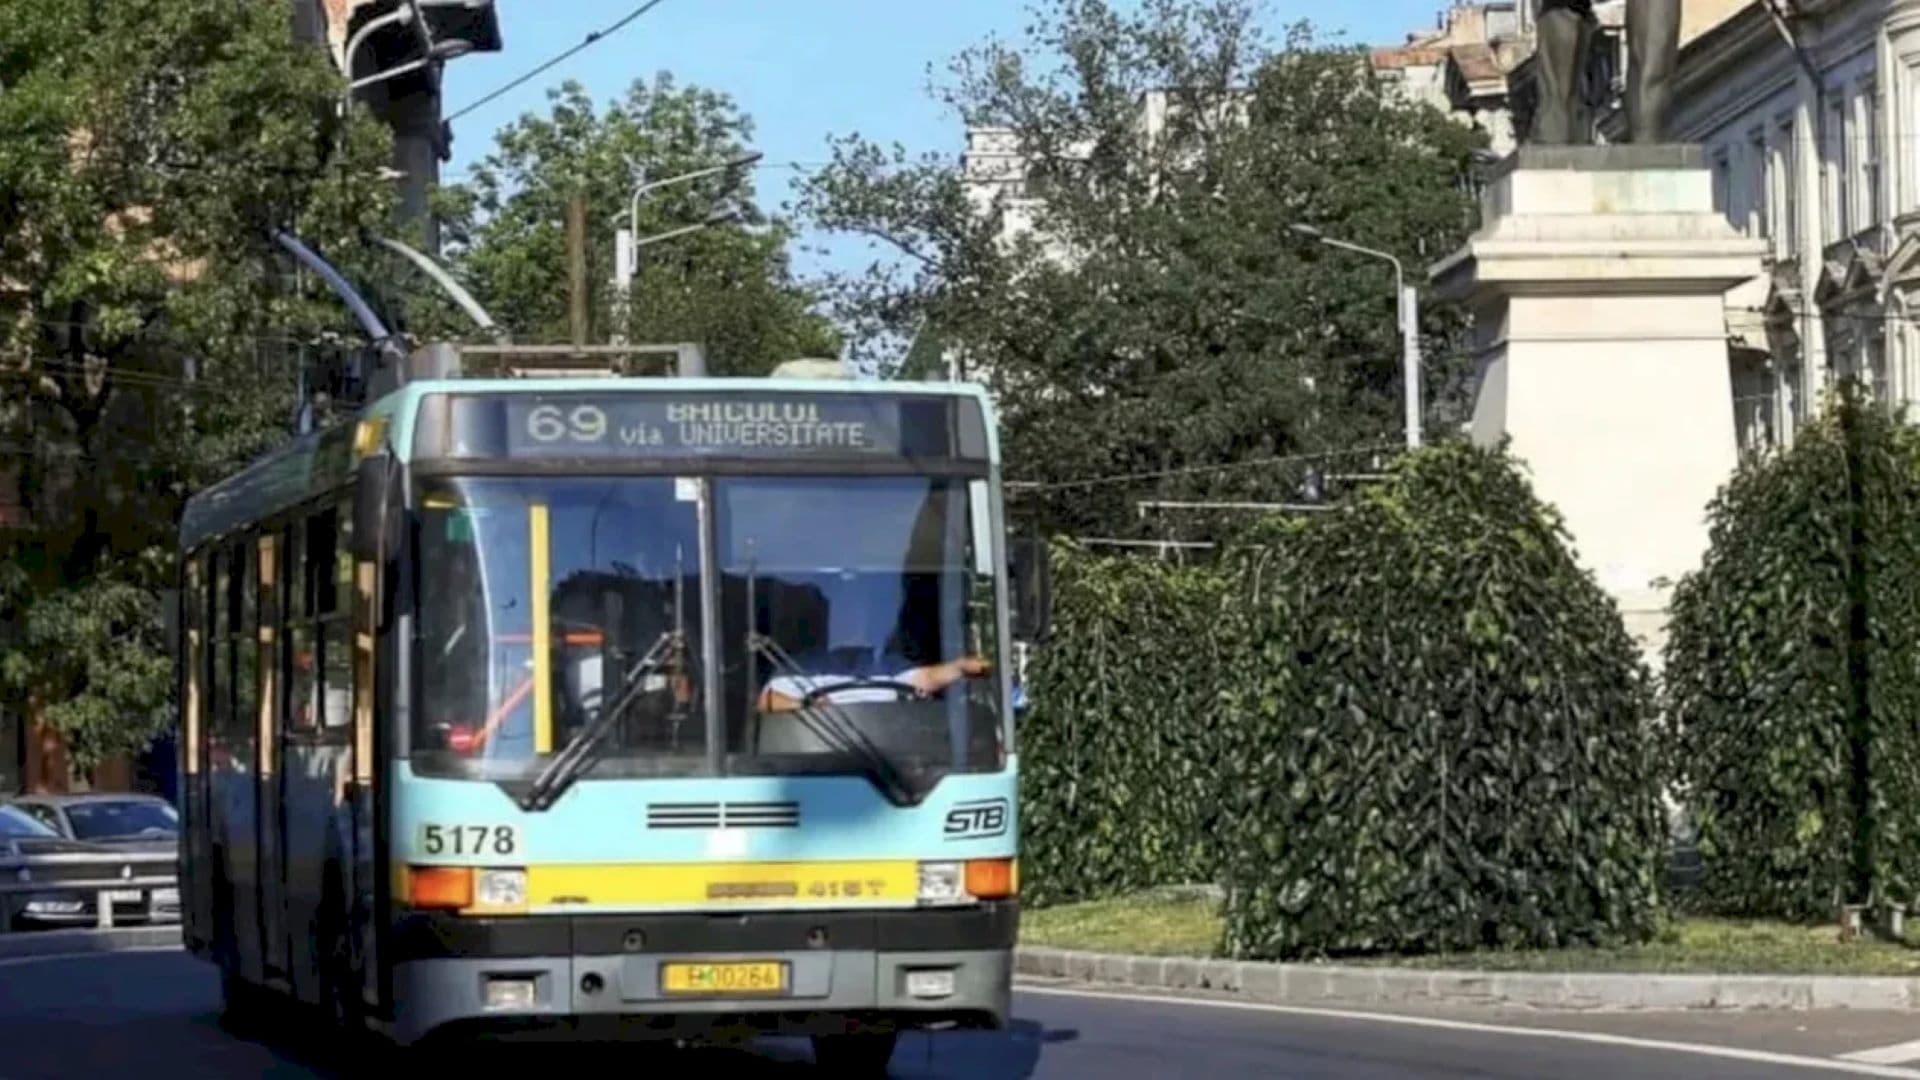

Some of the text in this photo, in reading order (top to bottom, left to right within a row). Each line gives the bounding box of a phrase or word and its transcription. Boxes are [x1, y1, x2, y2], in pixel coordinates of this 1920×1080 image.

[528, 404, 607, 442] 69
[619, 421, 865, 446] via UNIVERSITATE
[944, 806, 1006, 834] STB
[424, 825, 515, 855] 5178
